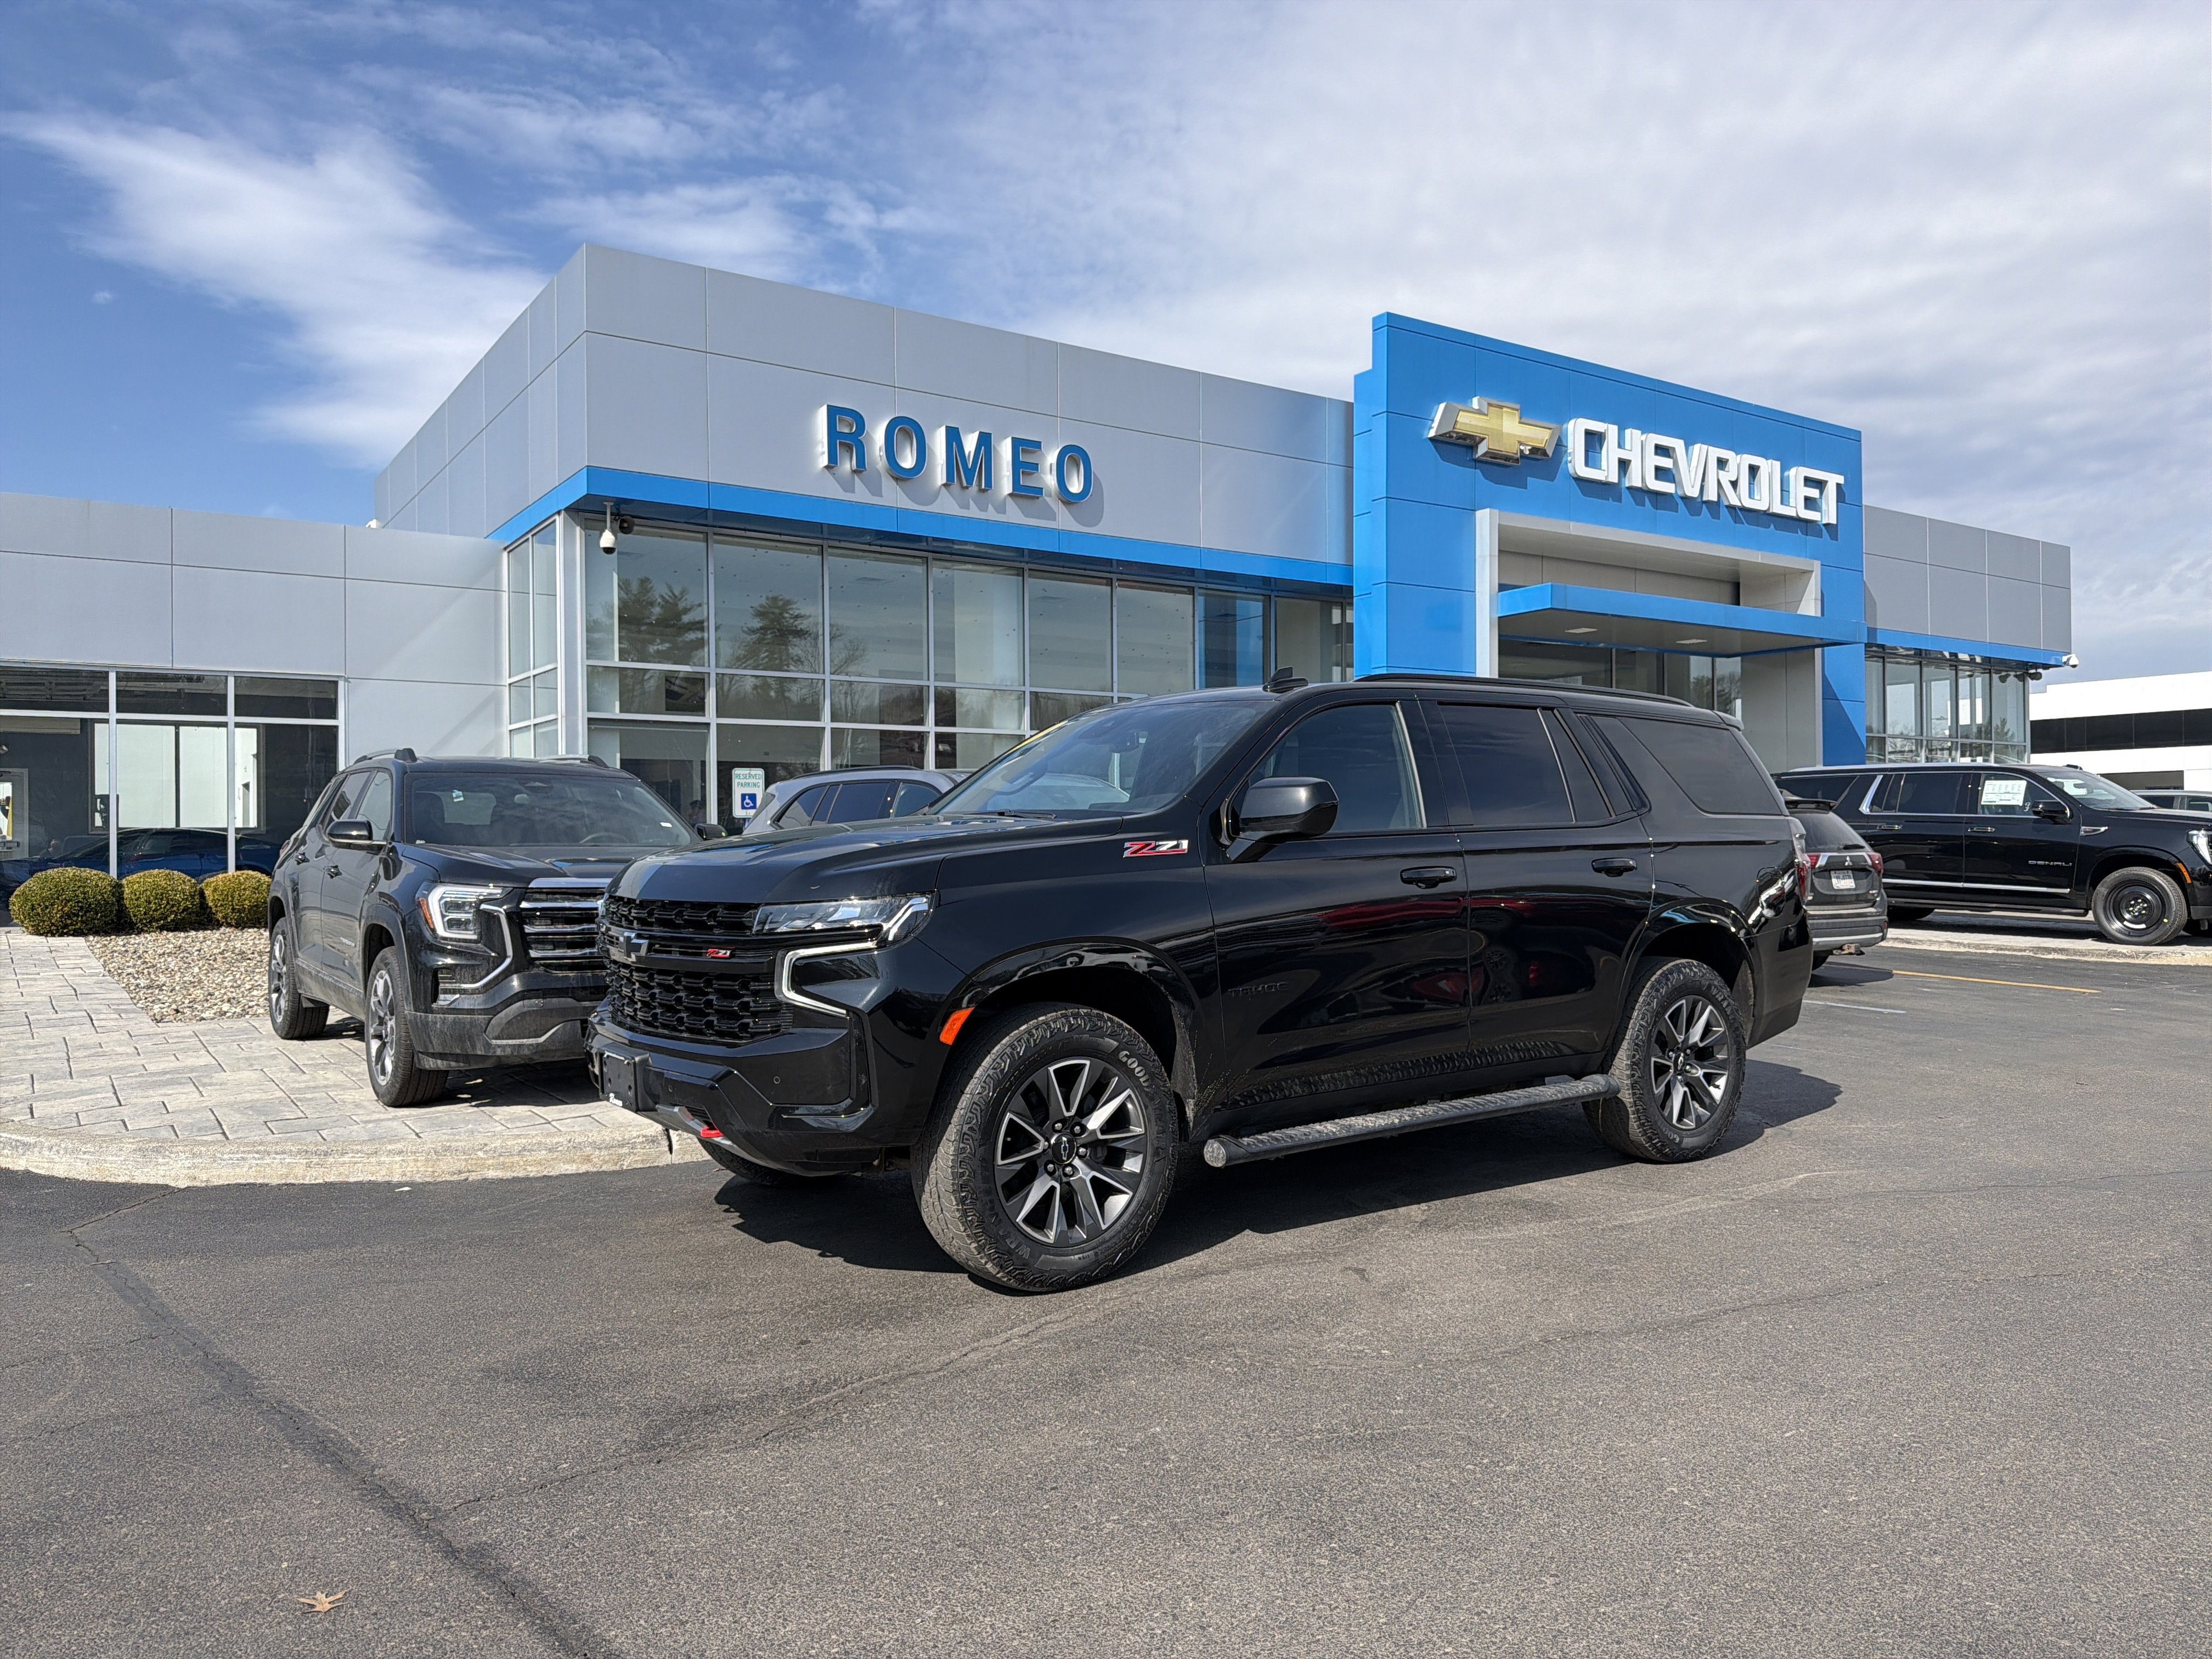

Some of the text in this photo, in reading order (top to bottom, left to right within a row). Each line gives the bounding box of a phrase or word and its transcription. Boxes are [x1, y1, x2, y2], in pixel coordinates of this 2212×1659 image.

[822, 404, 1093, 504] ROMEO
[1567, 417, 1844, 524] CHEVROLET
[1123, 839, 1189, 857] Z71
